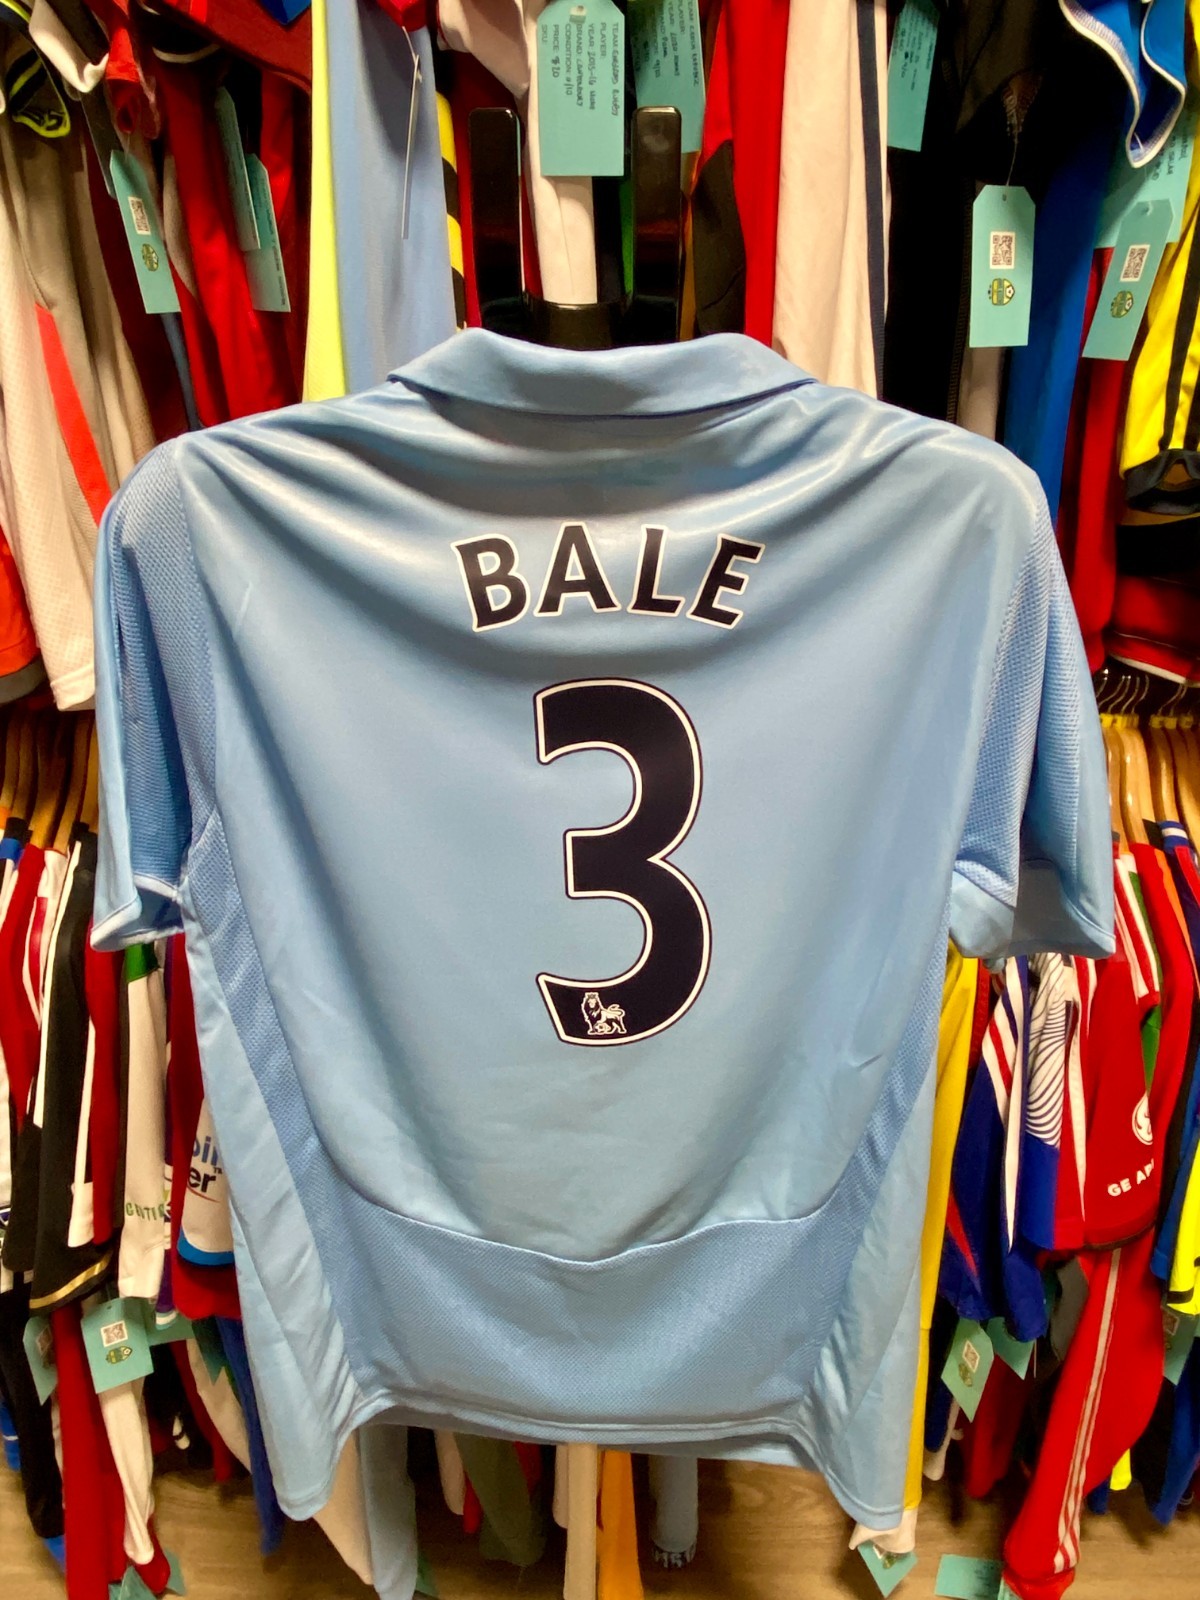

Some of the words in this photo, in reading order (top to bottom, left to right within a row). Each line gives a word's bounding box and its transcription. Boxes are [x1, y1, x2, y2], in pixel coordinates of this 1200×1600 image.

[451, 522, 765, 631] BALE
[533, 677, 712, 1046] 3
[1107, 1178, 1132, 1197] GE
